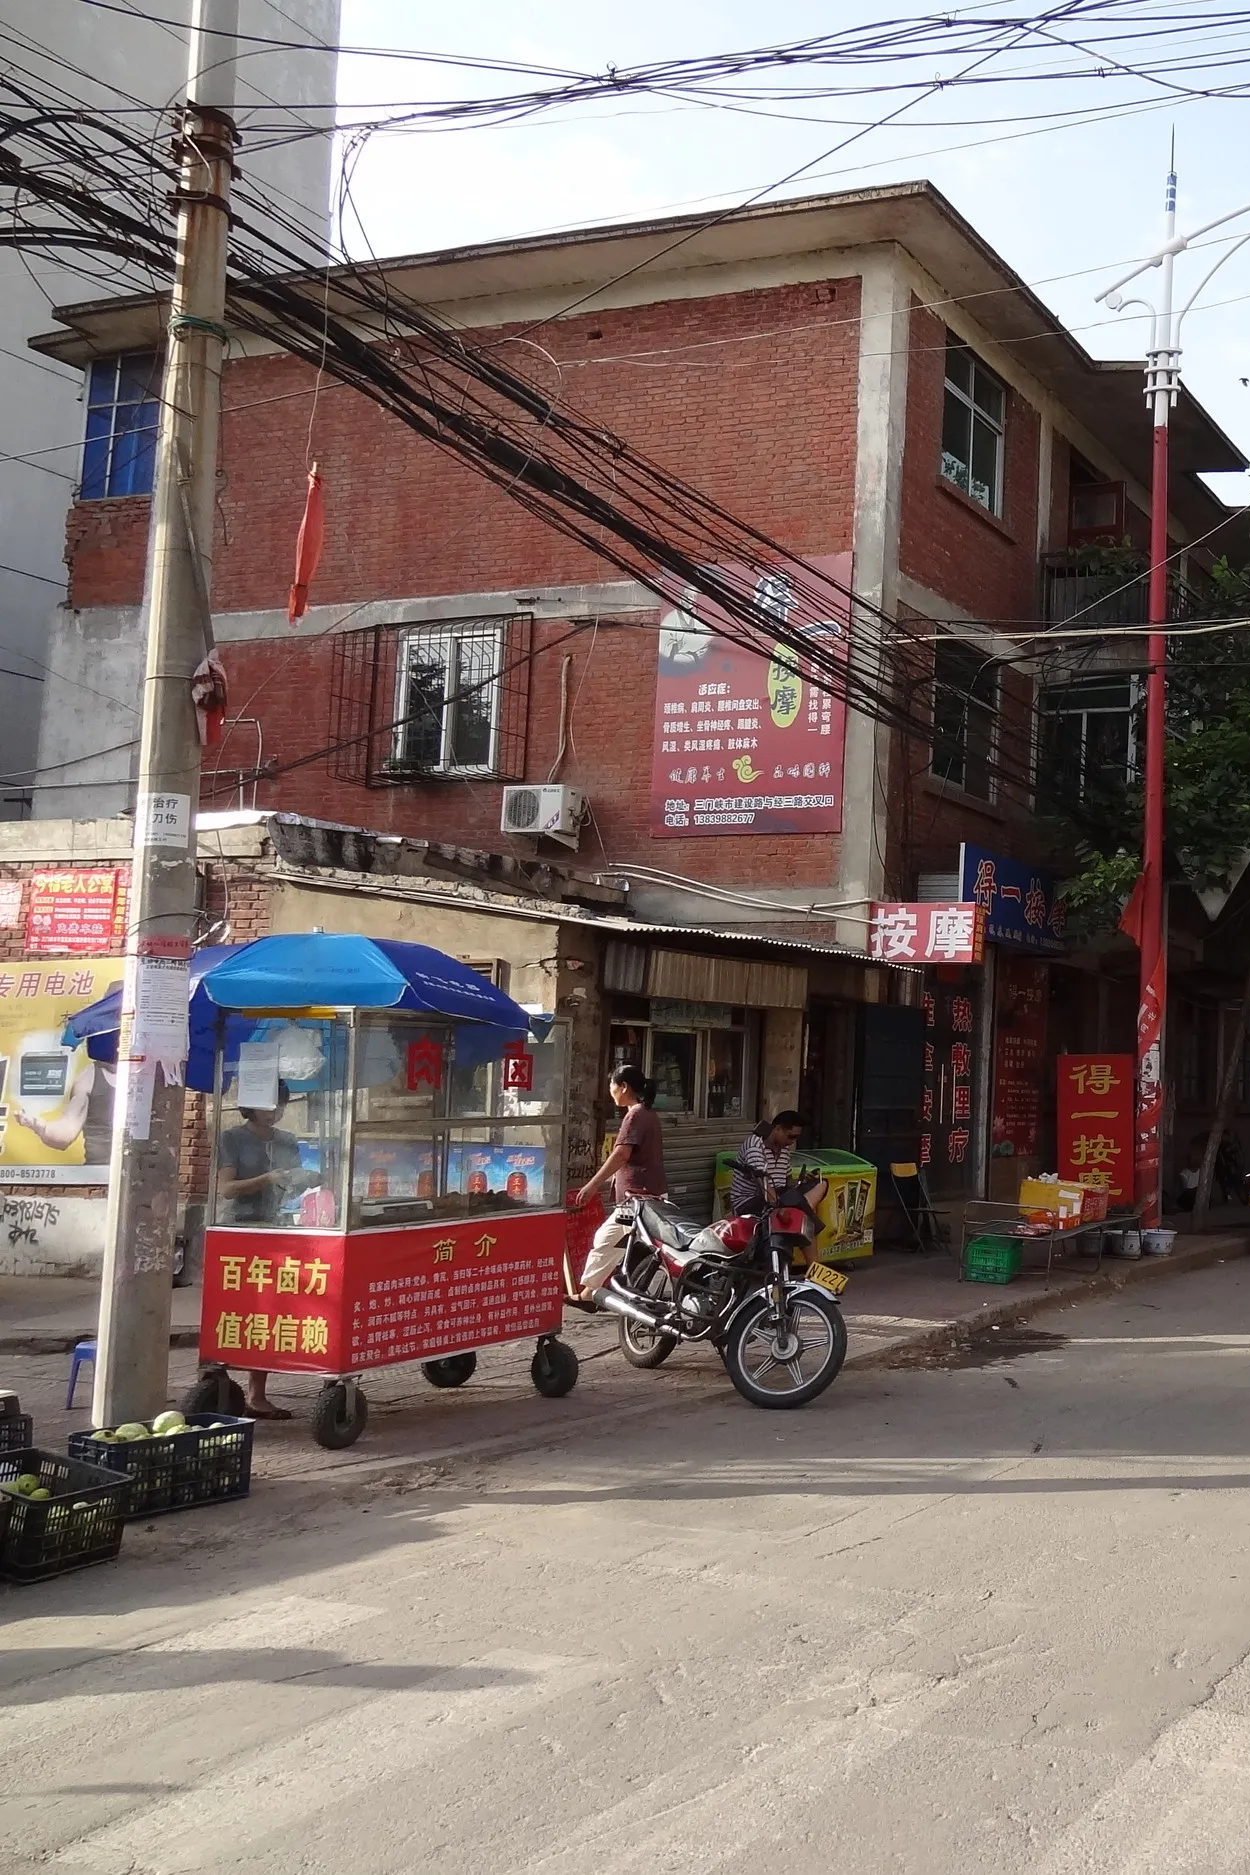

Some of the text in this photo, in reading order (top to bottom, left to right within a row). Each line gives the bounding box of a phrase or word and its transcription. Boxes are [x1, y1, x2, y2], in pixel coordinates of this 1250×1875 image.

[771, 655, 798, 715] 按摩
[870, 907, 974, 959] 按摩
[1069, 1063, 1123, 1196] 得一按摩
[433, 1233, 497, 1264] 简介
[220, 1255, 331, 1296] 百年卤方
[215, 1311, 329, 1355] 值得信赖
